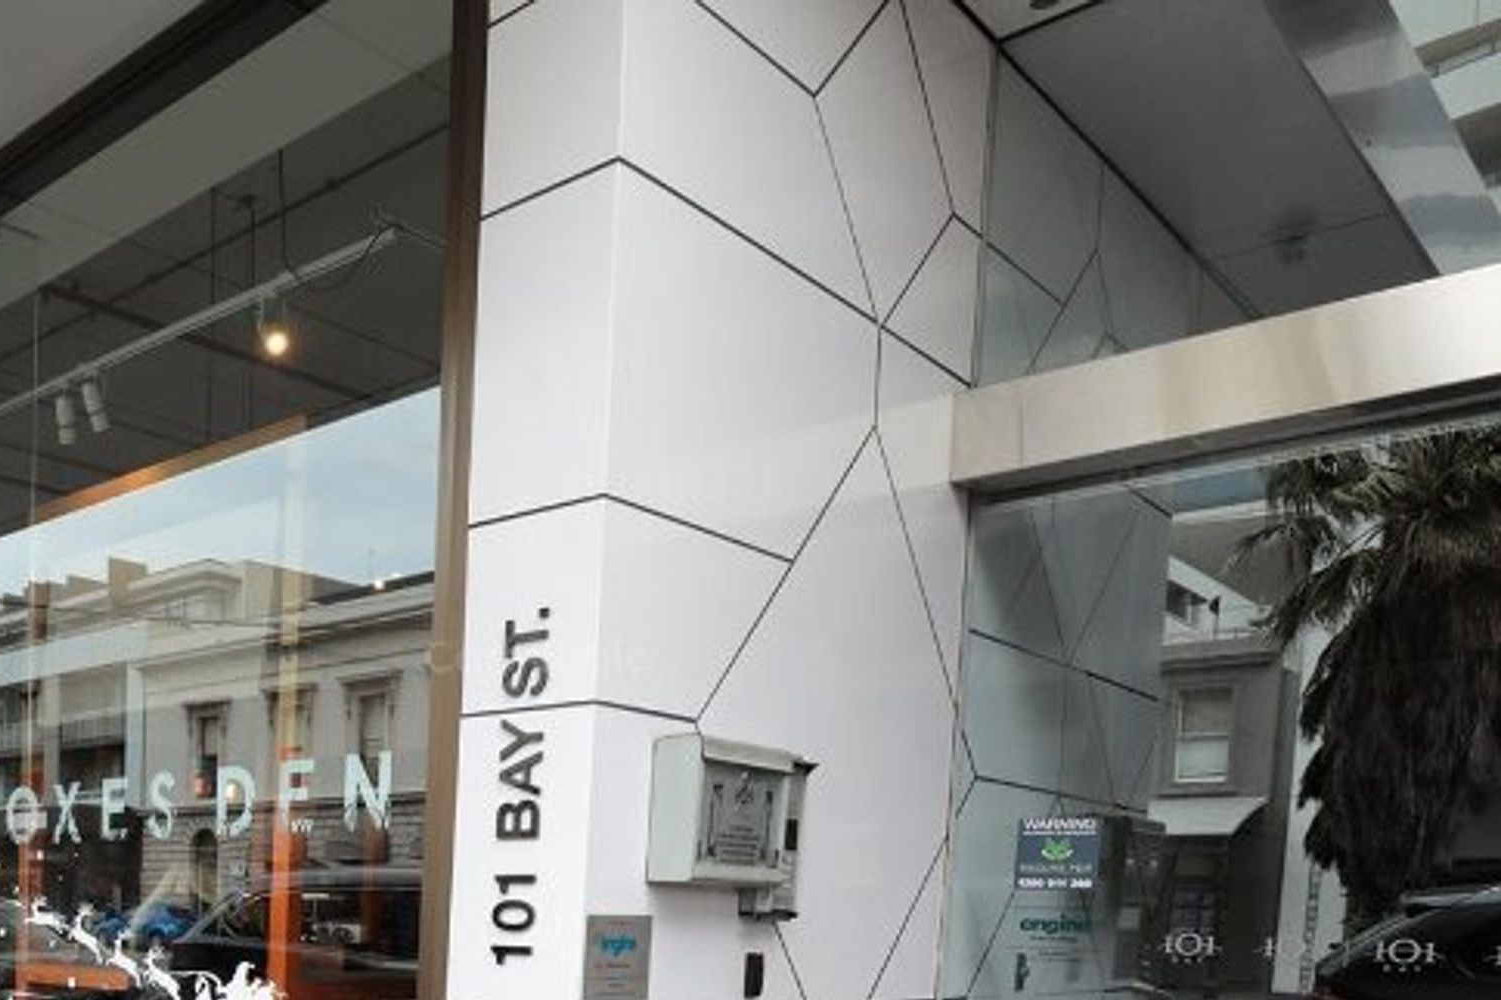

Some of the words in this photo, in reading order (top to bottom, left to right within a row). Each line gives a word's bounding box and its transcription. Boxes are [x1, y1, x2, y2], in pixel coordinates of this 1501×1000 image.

[501, 606, 552, 698] ST.
[216, 752, 394, 836] DEN
[495, 719, 545, 841] BAY
[1022, 817, 1097, 830] WARNING
[489, 873, 537, 966] 101
[1163, 932, 1215, 955] 101
[1376, 938, 1435, 963] 101
